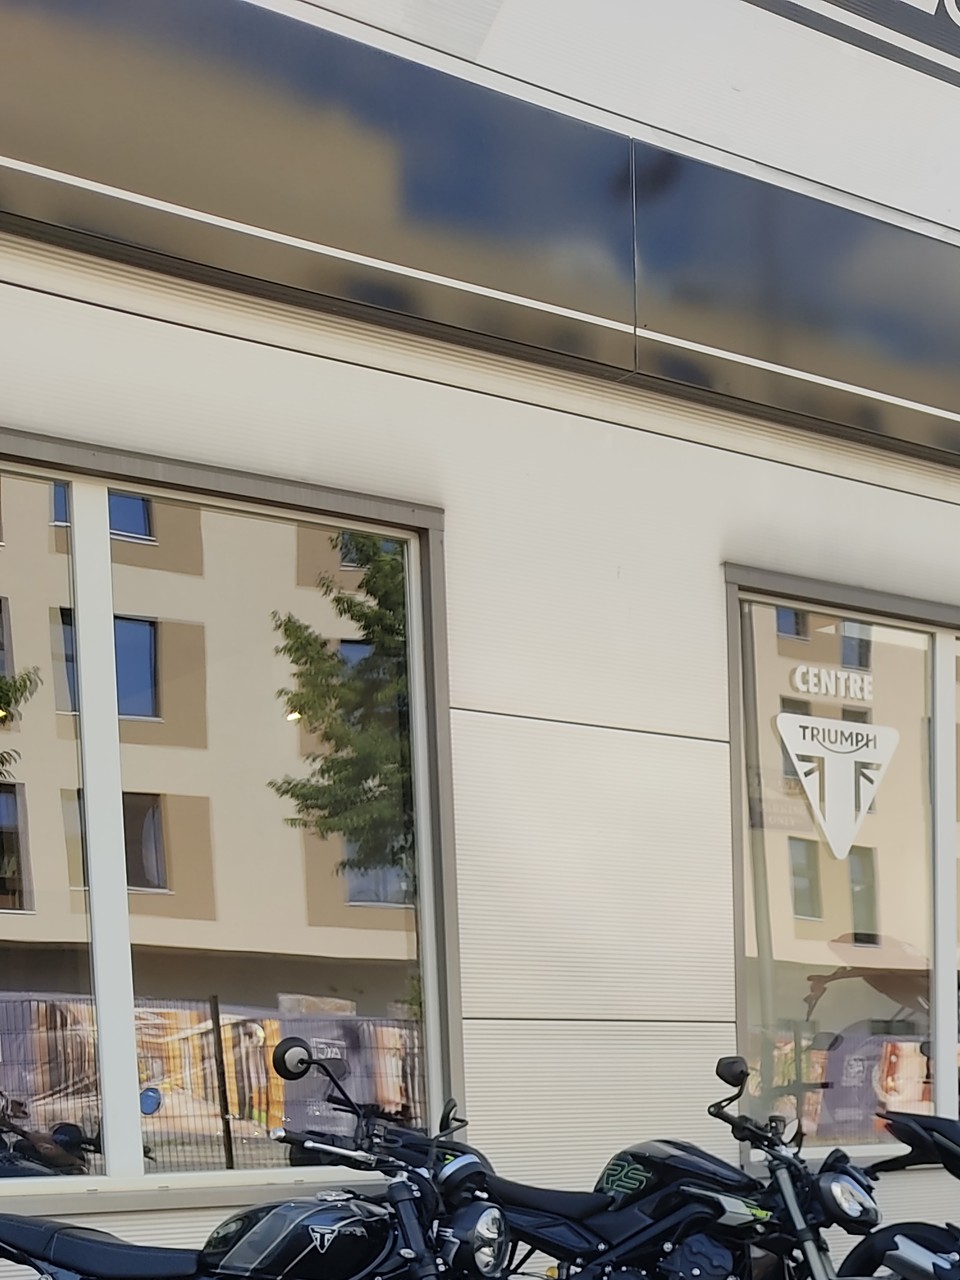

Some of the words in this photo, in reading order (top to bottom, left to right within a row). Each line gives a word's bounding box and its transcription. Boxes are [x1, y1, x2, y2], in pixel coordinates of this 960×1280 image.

[794, 664, 874, 700] CENTRE
[798, 725, 878, 754] TRIUMPH
[603, 1159, 653, 1194] RS
